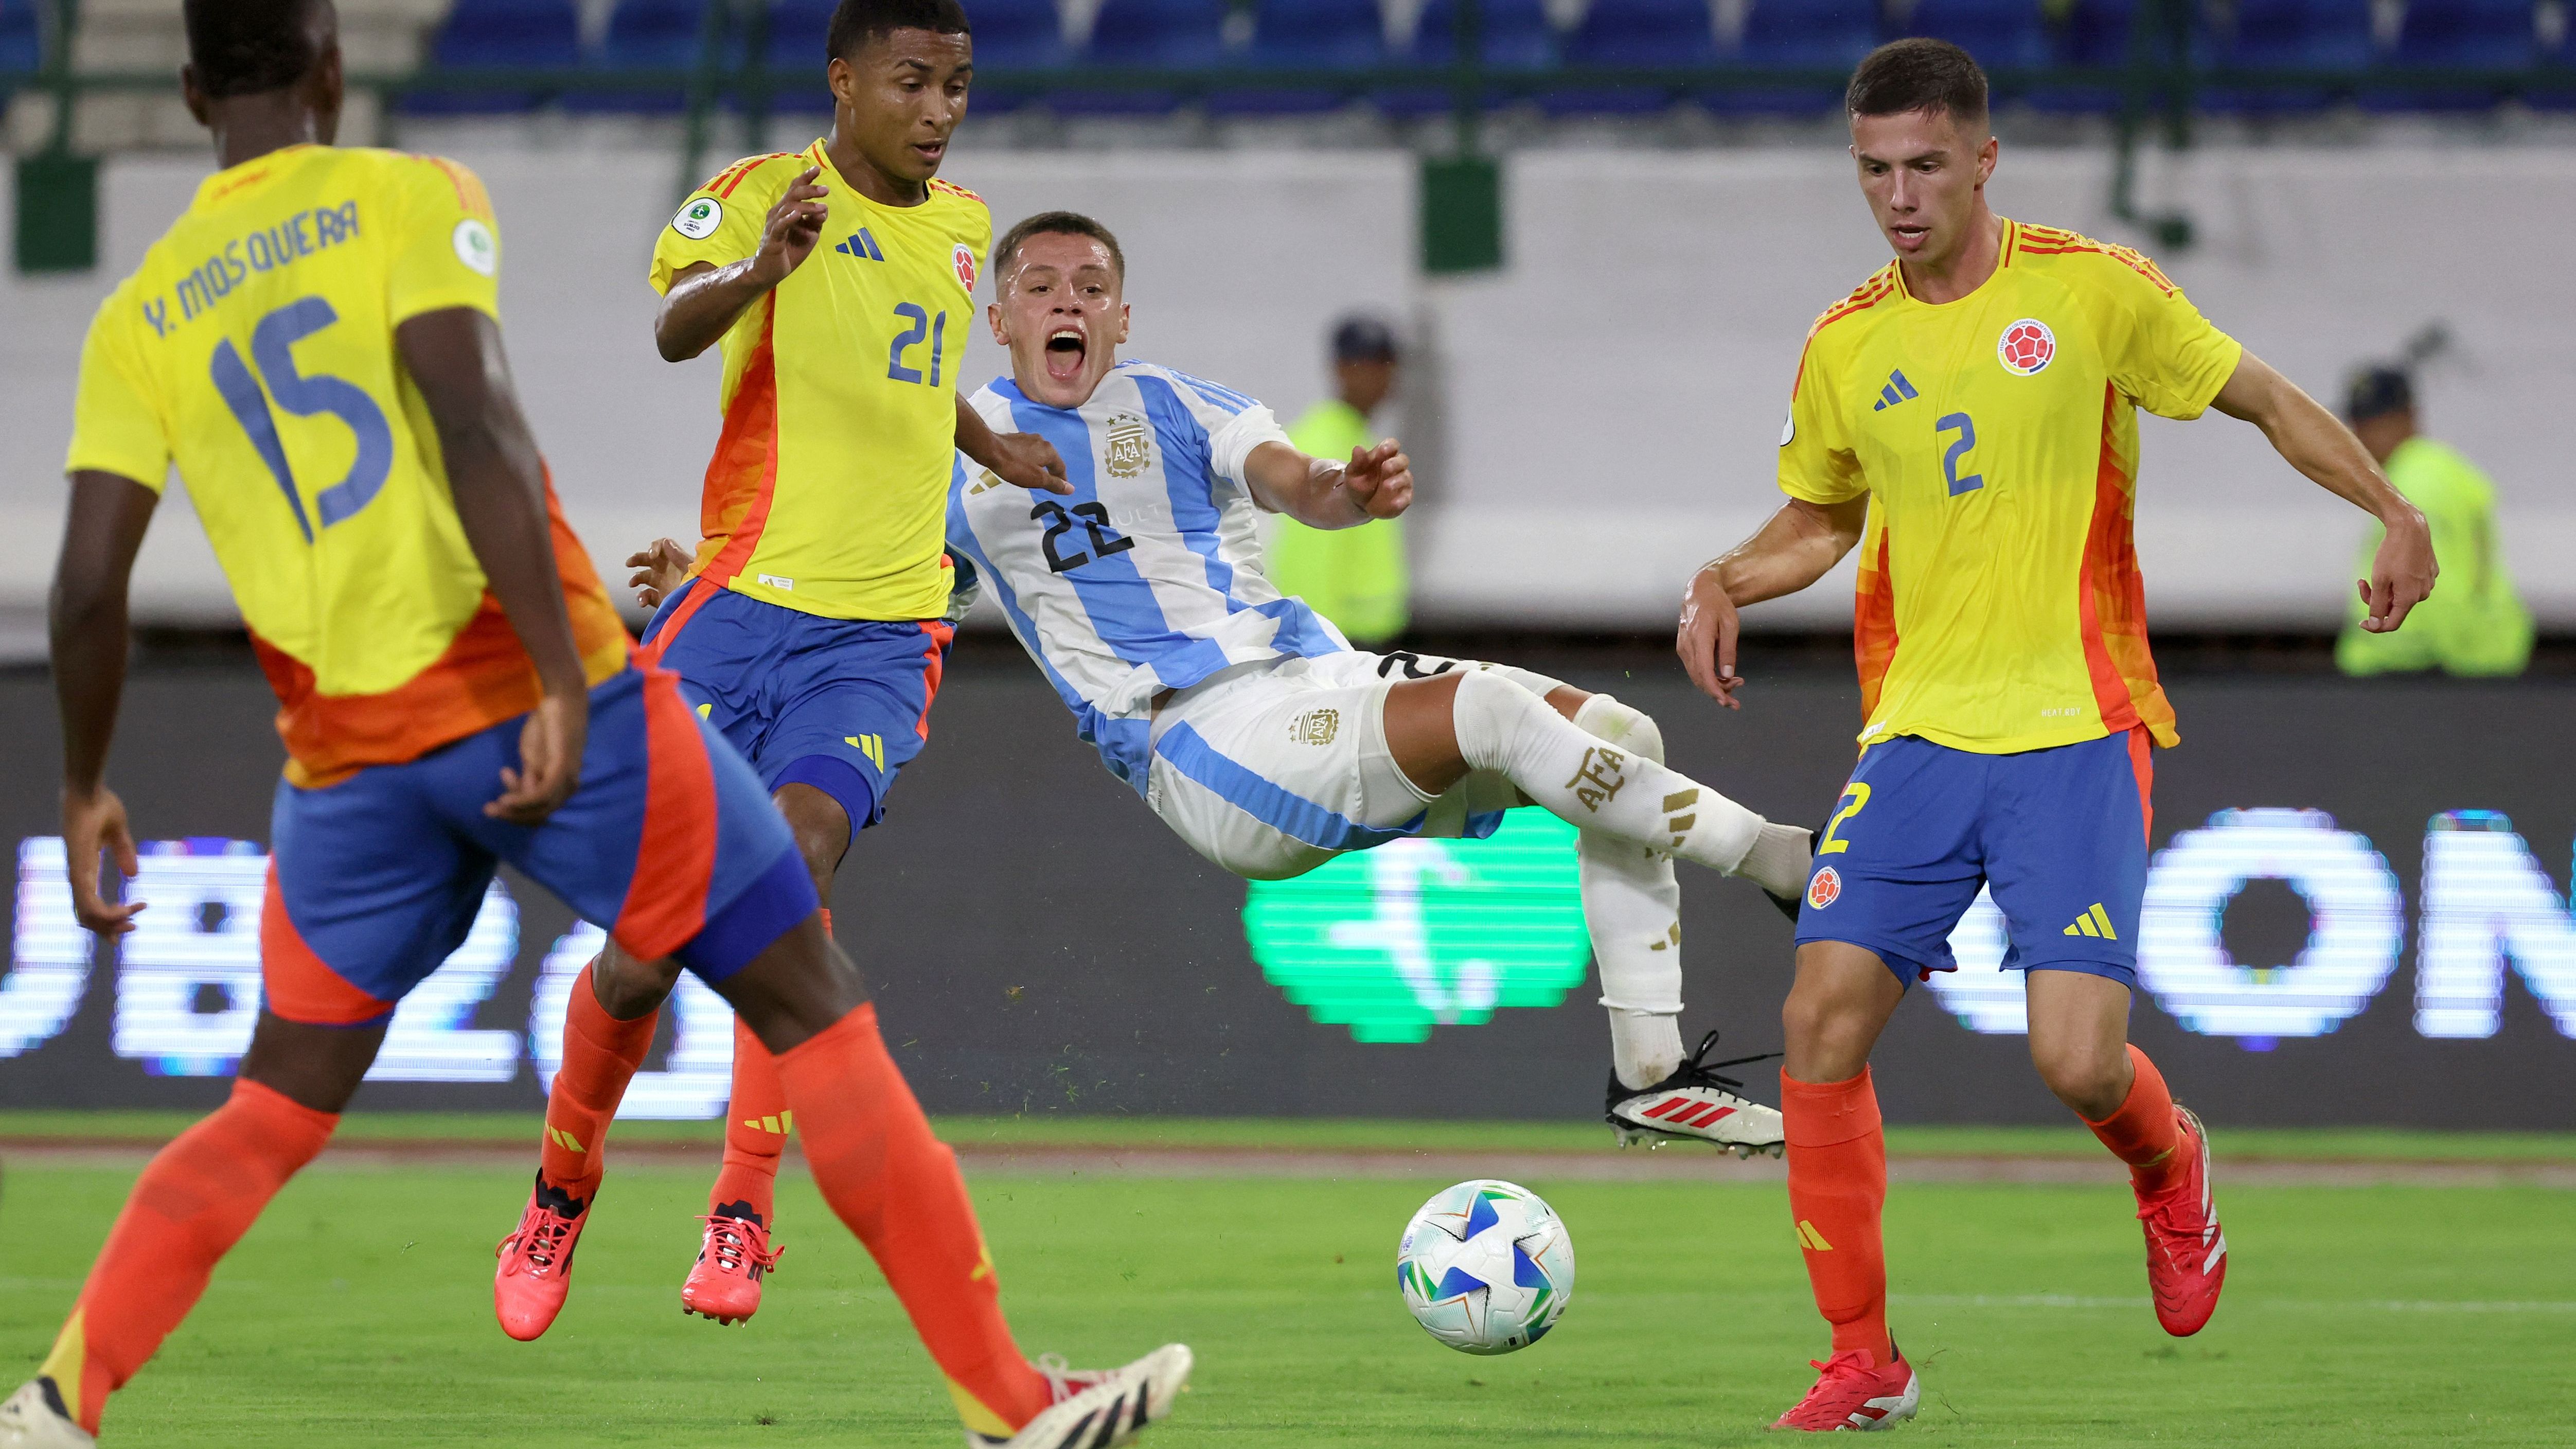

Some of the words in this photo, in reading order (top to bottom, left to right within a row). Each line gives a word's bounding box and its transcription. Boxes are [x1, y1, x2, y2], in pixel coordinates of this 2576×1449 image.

[144, 301, 176, 339] Y.
[176, 200, 360, 321] MOSQUERA
[888, 302, 946, 387] 21
[210, 295, 393, 544] 15
[1114, 438, 1141, 463] AFA
[1935, 412, 1983, 497] 2
[1031, 501, 1135, 573] 22
[2041, 708, 2080, 717] HEAT.RDY
[1565, 747, 1624, 813] AFA
[1819, 782, 1871, 856] 2
